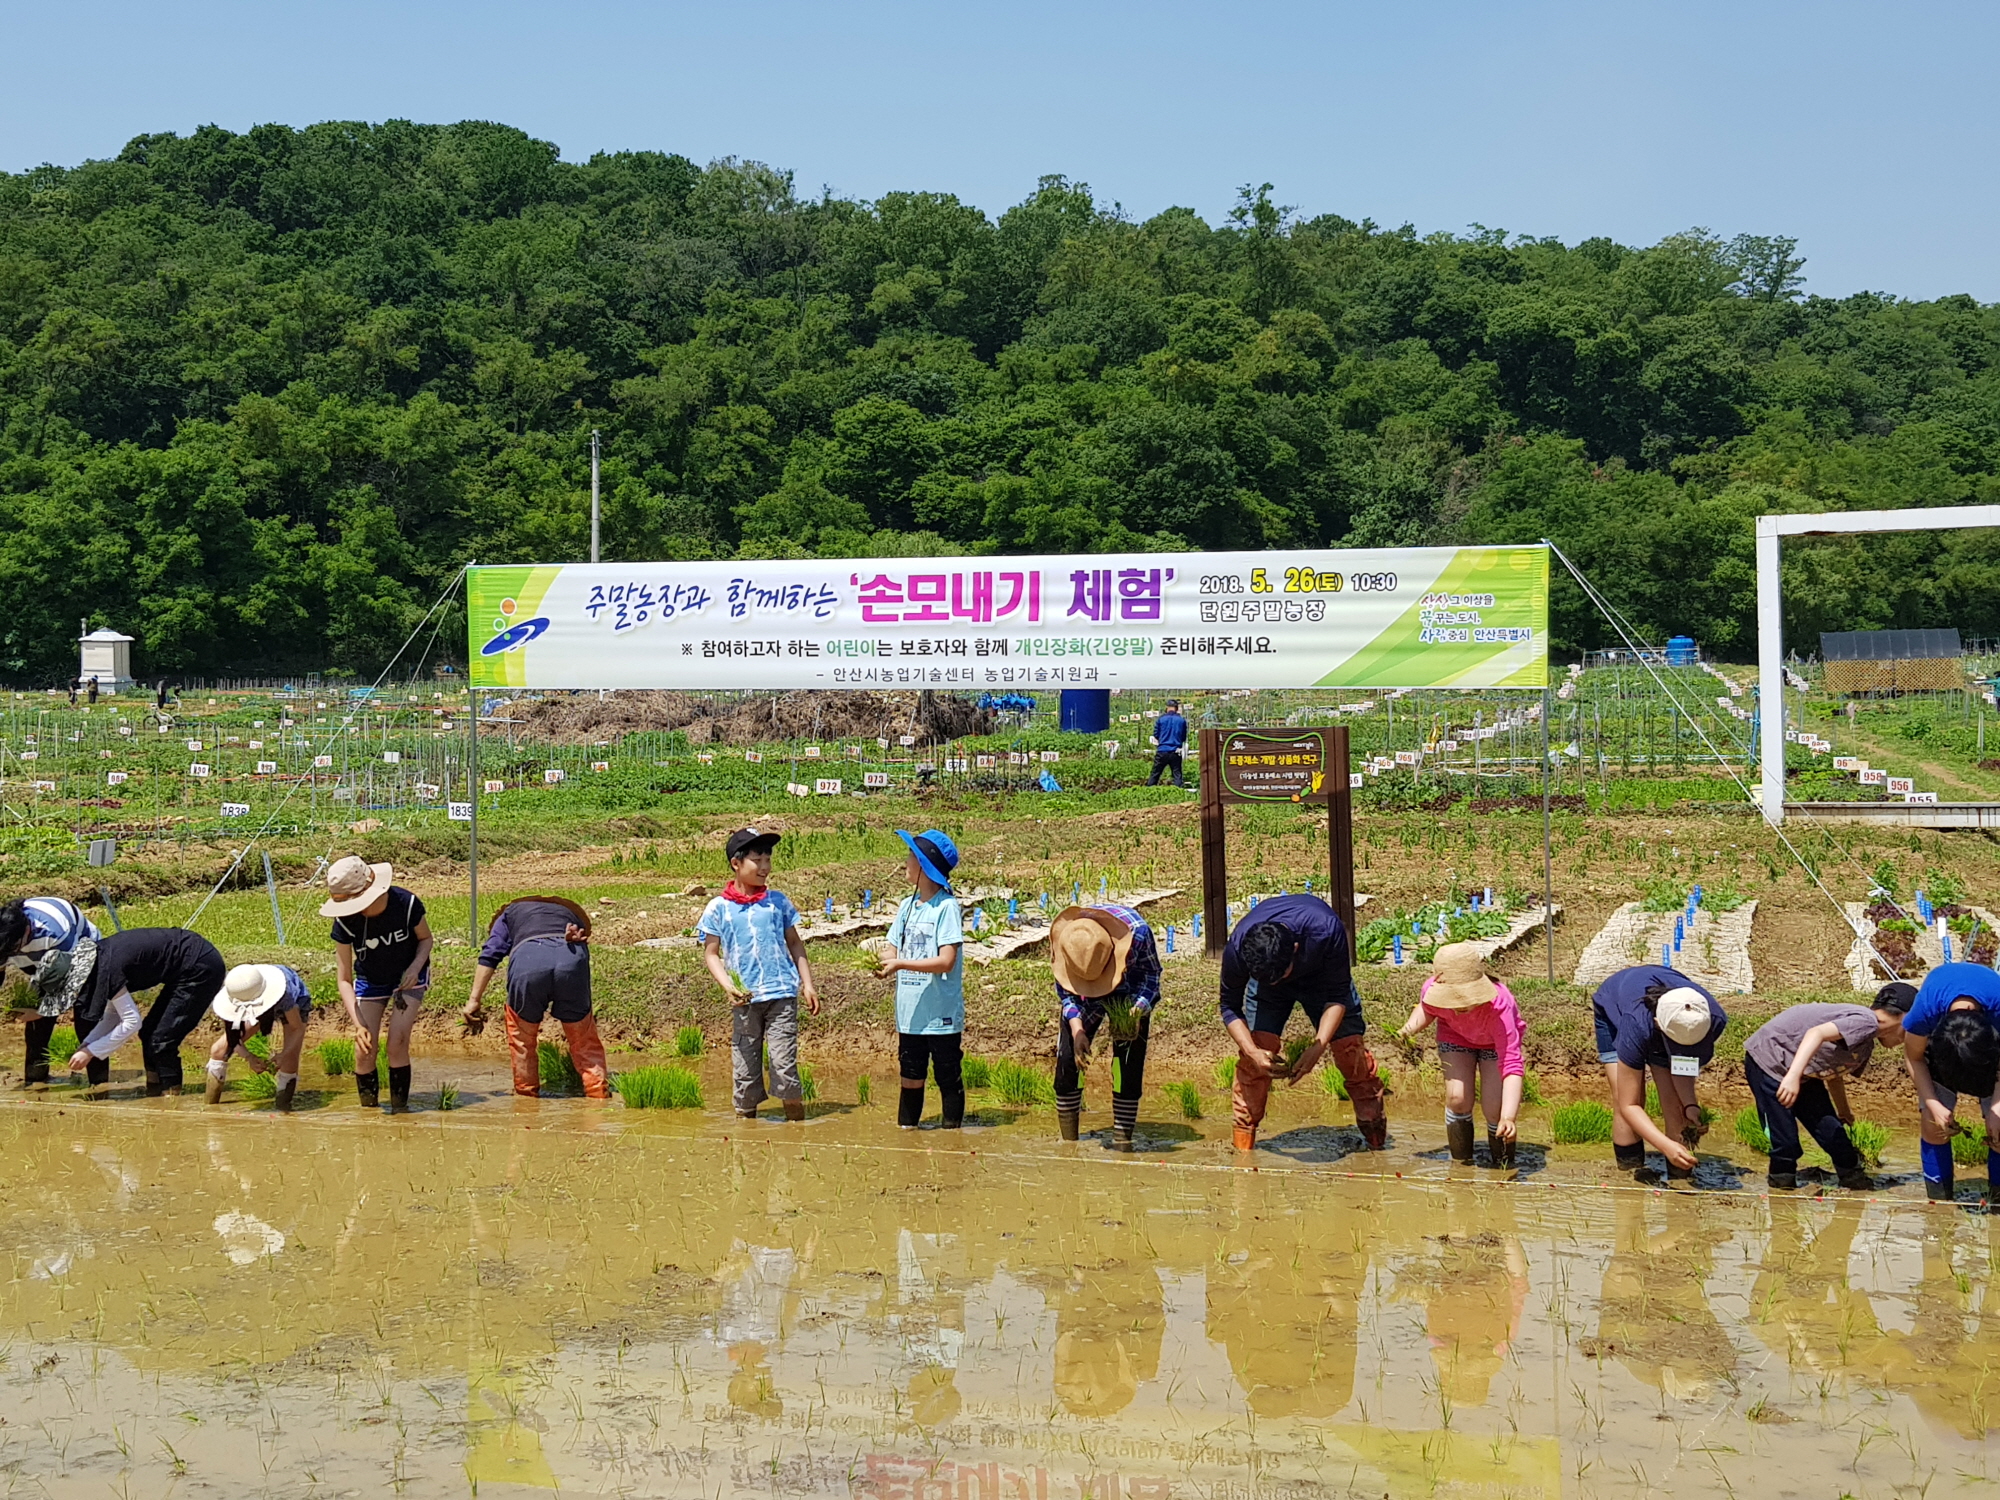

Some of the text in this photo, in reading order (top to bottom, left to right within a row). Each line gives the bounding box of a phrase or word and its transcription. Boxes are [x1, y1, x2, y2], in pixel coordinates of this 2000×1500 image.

[1200, 567, 1397, 593] 2018. 5. 26(토) 10:30
[585, 582, 711, 630] 주말농장과
[726, 578, 837, 617] 함께하는
[1200, 600, 1326, 622] 단원주말농장
[1474, 629, 1530, 640] 안산특별시
[701, 640, 782, 657] 참여하고자
[787, 639, 820, 657] 하는
[826, 639, 893, 657] 어린이는
[899, 638, 968, 657] 보호자와
[974, 638, 1008, 656] 함께
[1015, 637, 1154, 656] 개인장화(긴양말)
[1160, 636, 1277, 655] 준비해주세요.
[833, 666, 1099, 682] 안산시농업기술센터 농업기술지원과
[1302, 754, 1318, 765] 연구
[867, 775, 884, 783] 973
[820, 782, 837, 790] 972
[1891, 781, 1909, 790] 956
[451, 805, 472, 816] 1839
